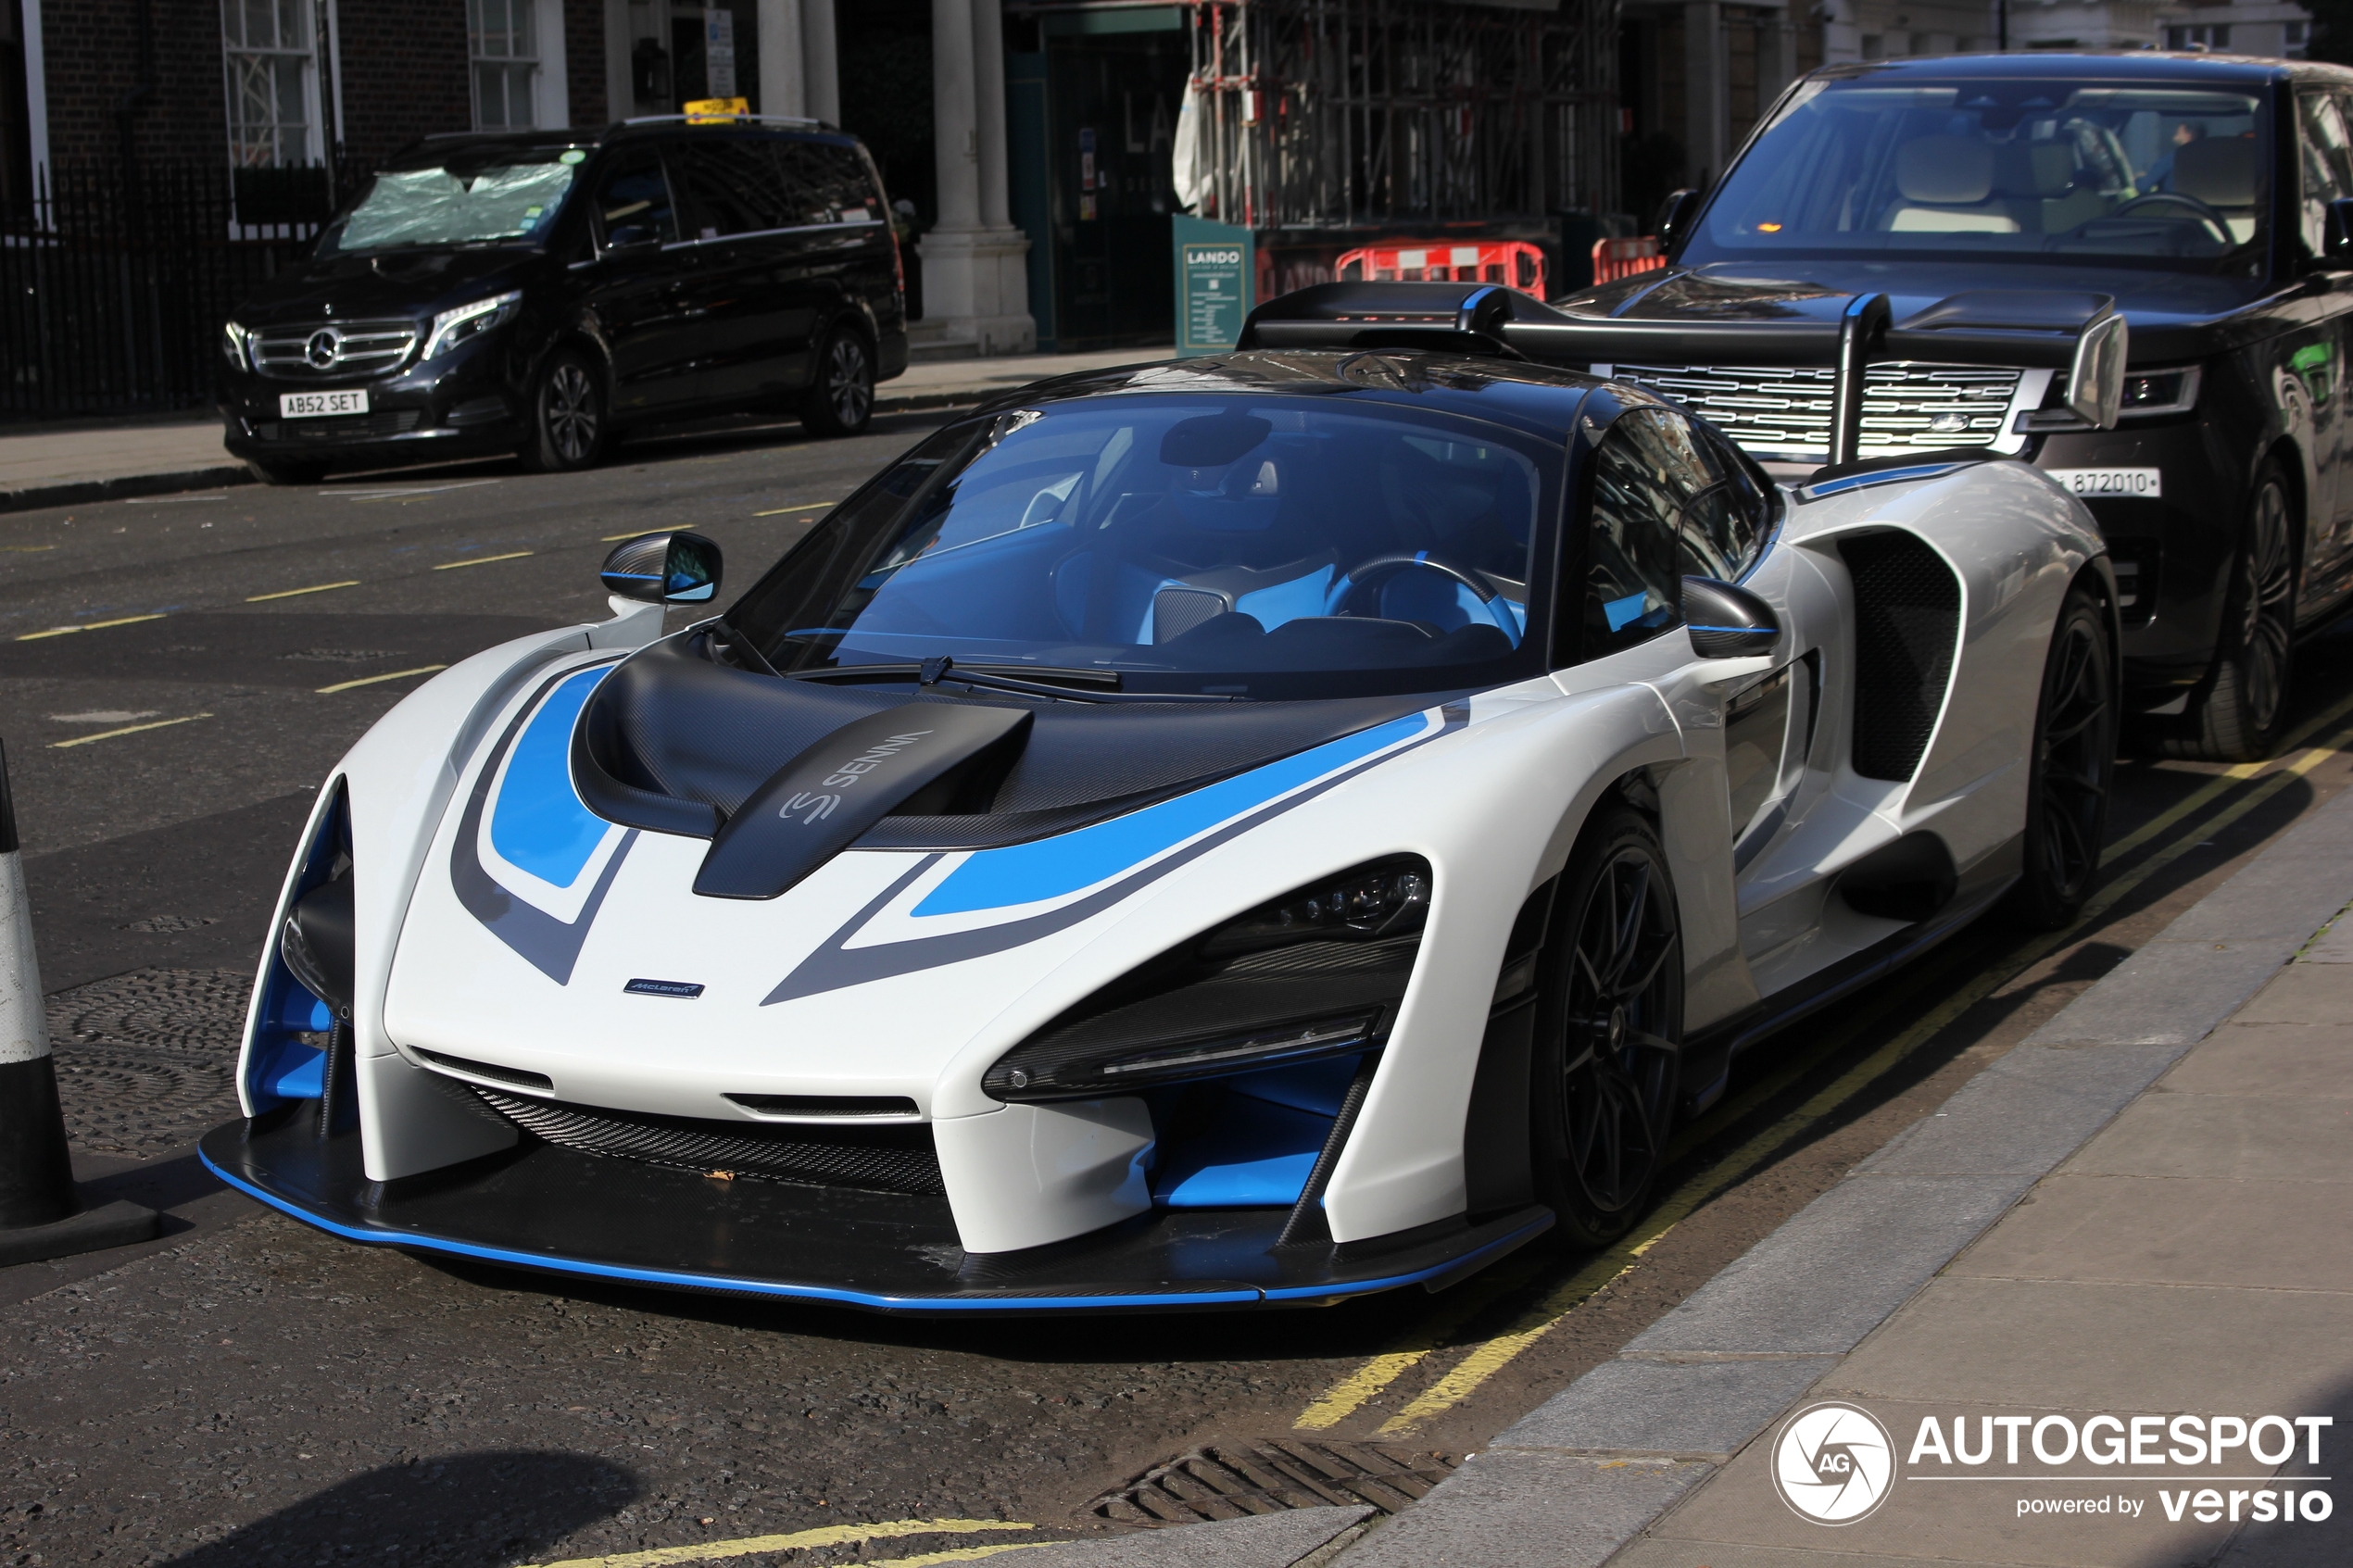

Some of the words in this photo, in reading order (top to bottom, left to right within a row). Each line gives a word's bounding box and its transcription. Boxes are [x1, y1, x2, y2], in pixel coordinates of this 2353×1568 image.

[1188, 251, 1240, 264] LANDO
[287, 396, 324, 414] AB52
[329, 394, 359, 411] SET
[2075, 473, 2146, 493] 872010
[822, 729, 935, 787] SENNA
[631, 983, 691, 993] McLaren
